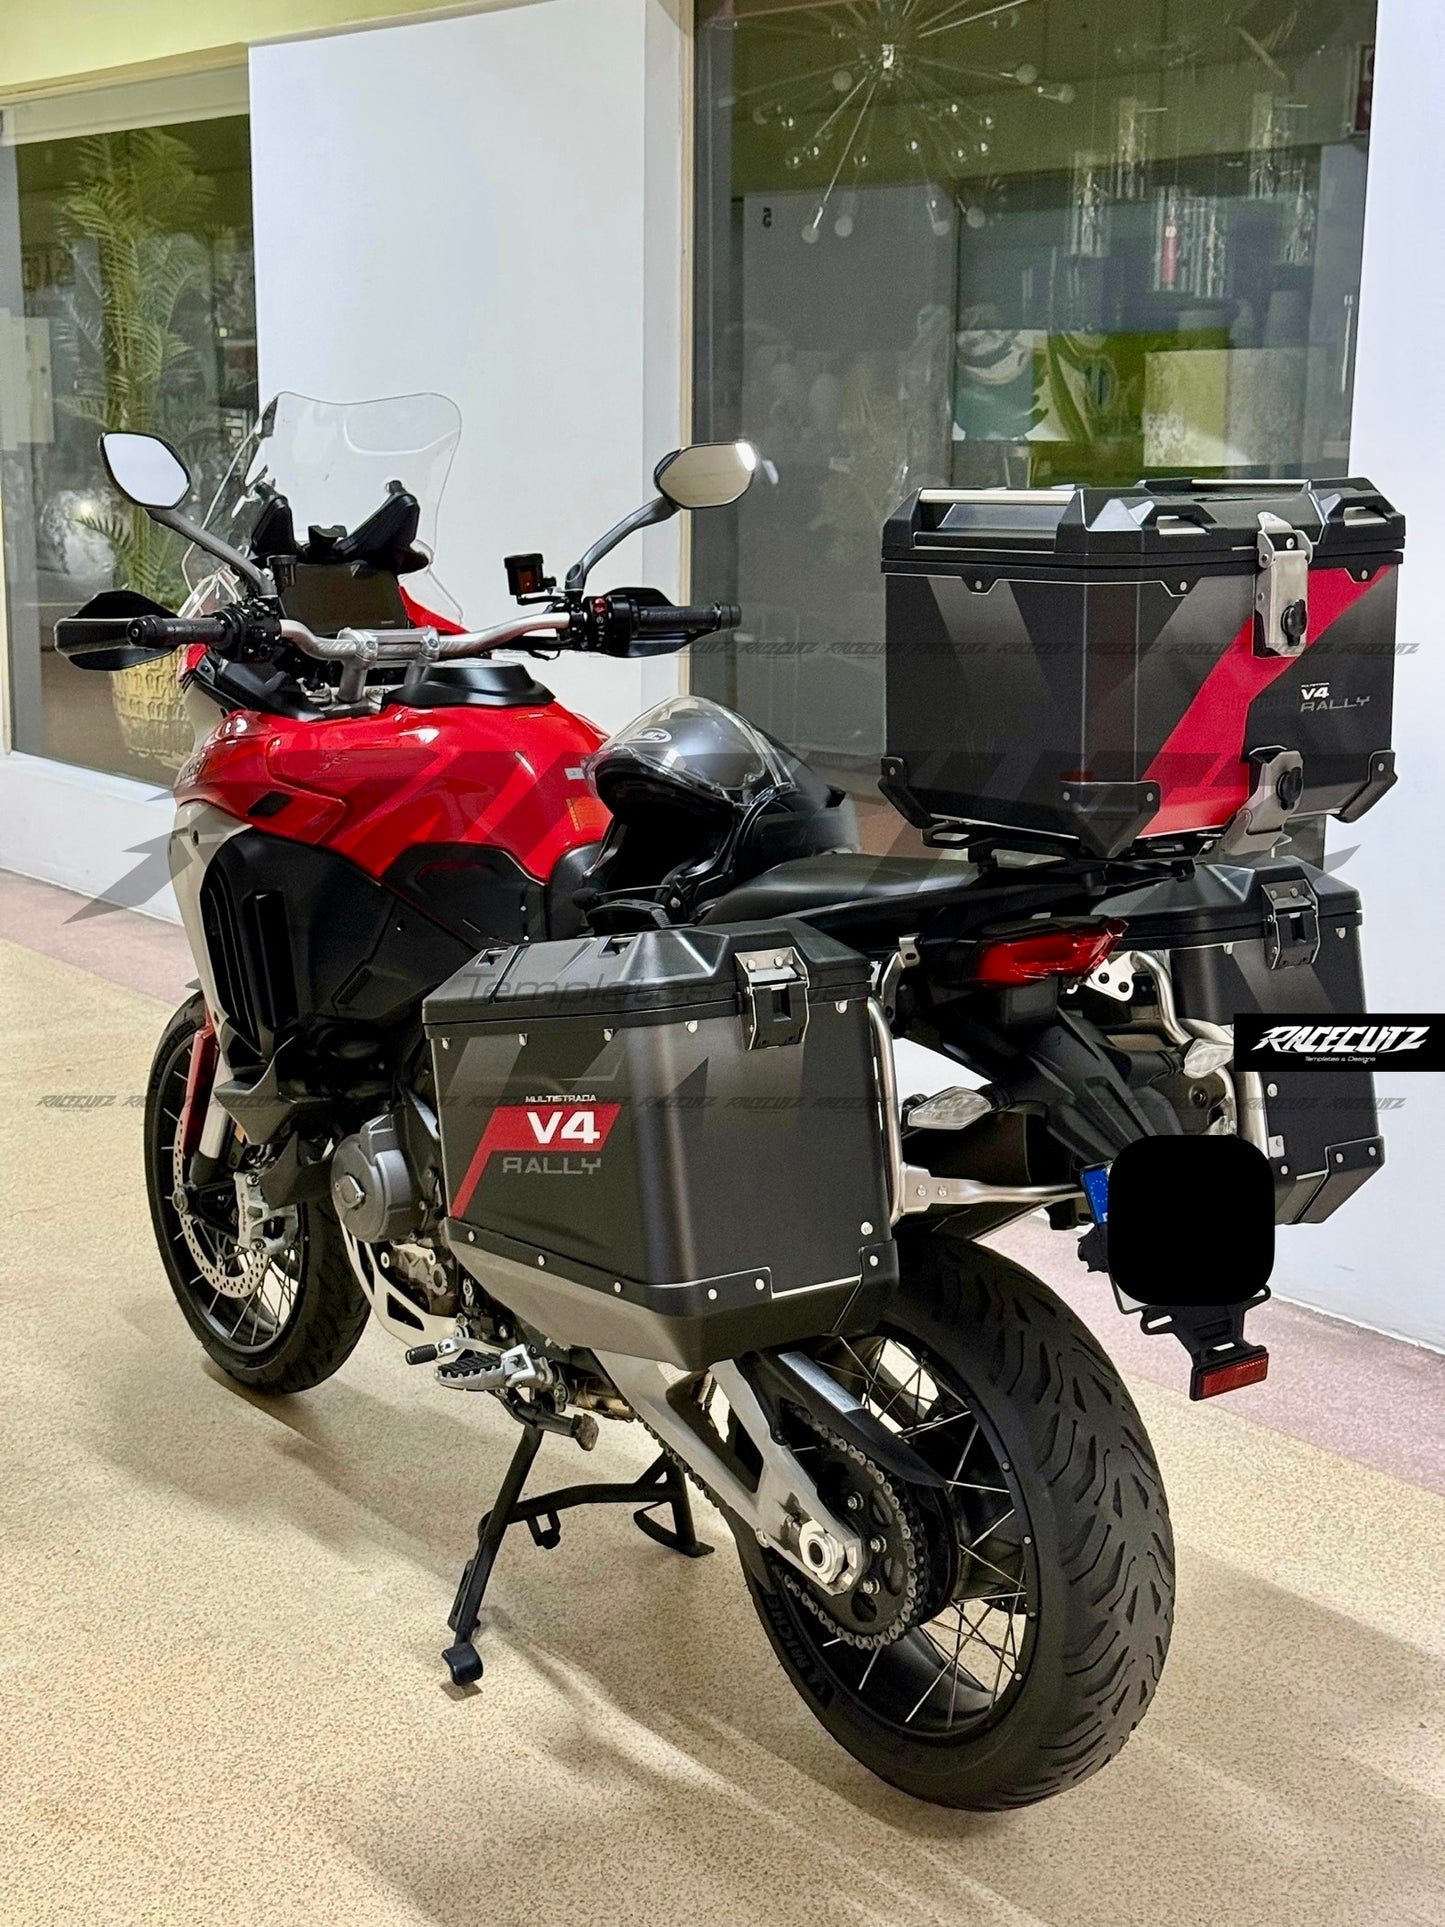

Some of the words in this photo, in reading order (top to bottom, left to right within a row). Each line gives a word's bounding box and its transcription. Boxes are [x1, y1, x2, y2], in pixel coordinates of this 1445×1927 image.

[1301, 686, 1330, 700] V4
[1300, 695, 1371, 713] RALLY
[525, 1094, 597, 1103] MULTISTRADA
[526, 1111, 601, 1144] V4
[502, 1156, 602, 1175] RALLY
